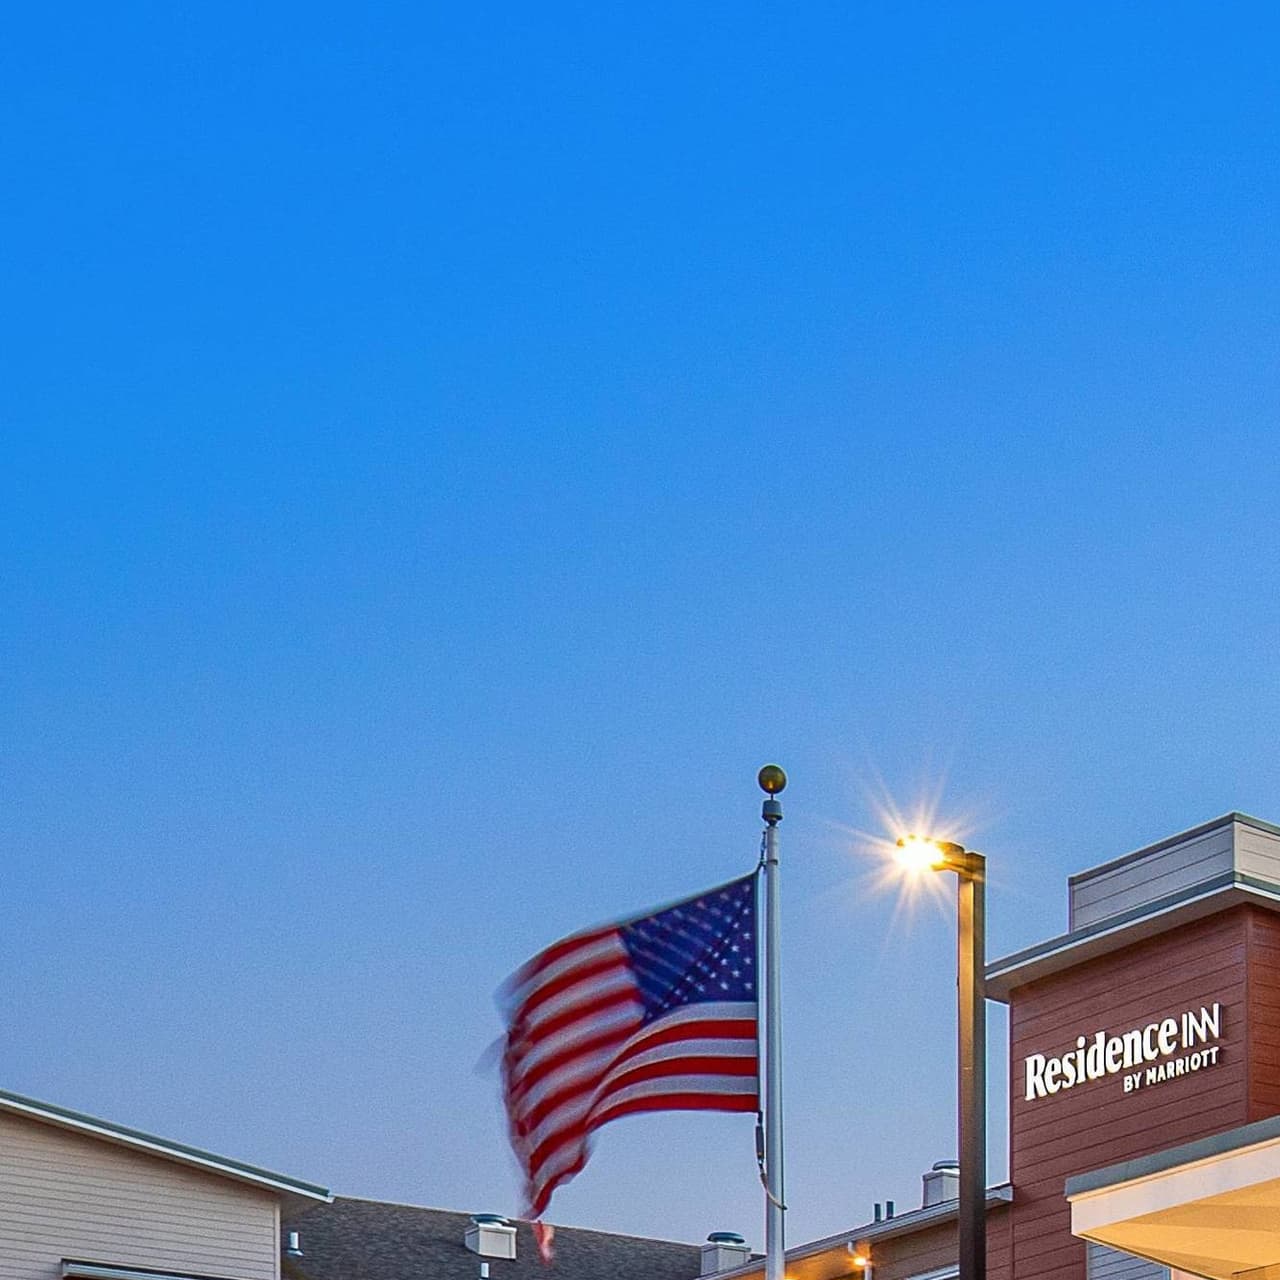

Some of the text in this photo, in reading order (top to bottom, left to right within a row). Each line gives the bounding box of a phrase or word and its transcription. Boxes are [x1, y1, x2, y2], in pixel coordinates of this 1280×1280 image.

[1025, 1003, 1221, 1101] Residence INN
[1123, 1047, 1220, 1093] BY MARRIOTT
